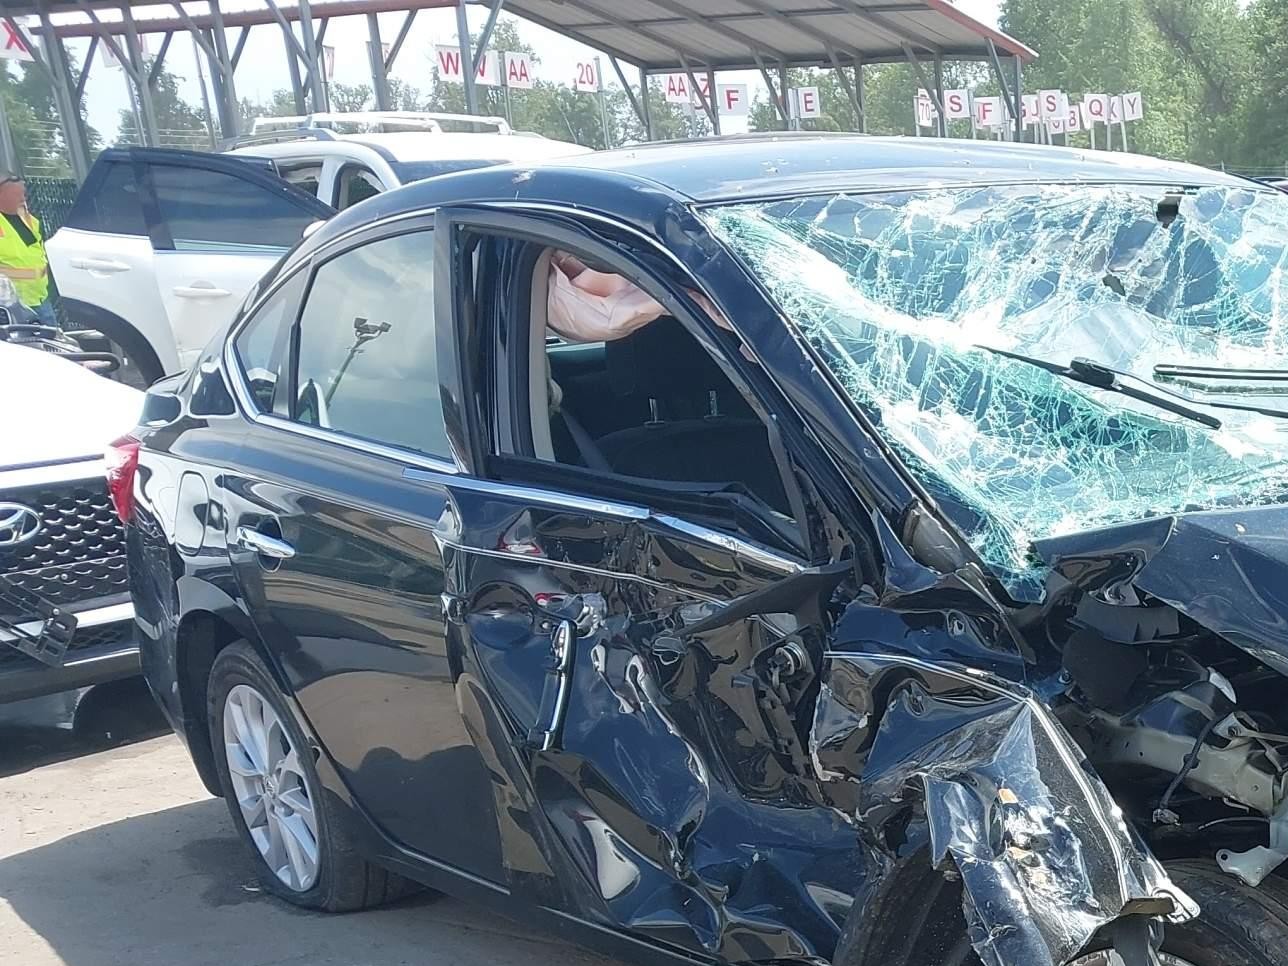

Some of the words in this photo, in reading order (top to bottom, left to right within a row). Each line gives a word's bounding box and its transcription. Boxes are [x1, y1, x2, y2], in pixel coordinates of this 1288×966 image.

[438, 51, 460, 76] W
[508, 58, 530, 82] AA
[576, 61, 594, 85] 20
[667, 75, 688, 97] AA
[725, 89, 739, 110] F
[804, 92, 815, 113] E
[948, 94, 963, 113] S
[1046, 95, 1057, 113] S
[1088, 98, 1104, 117] Q
[1127, 97, 1137, 115] Y
[982, 102, 993, 120] F
